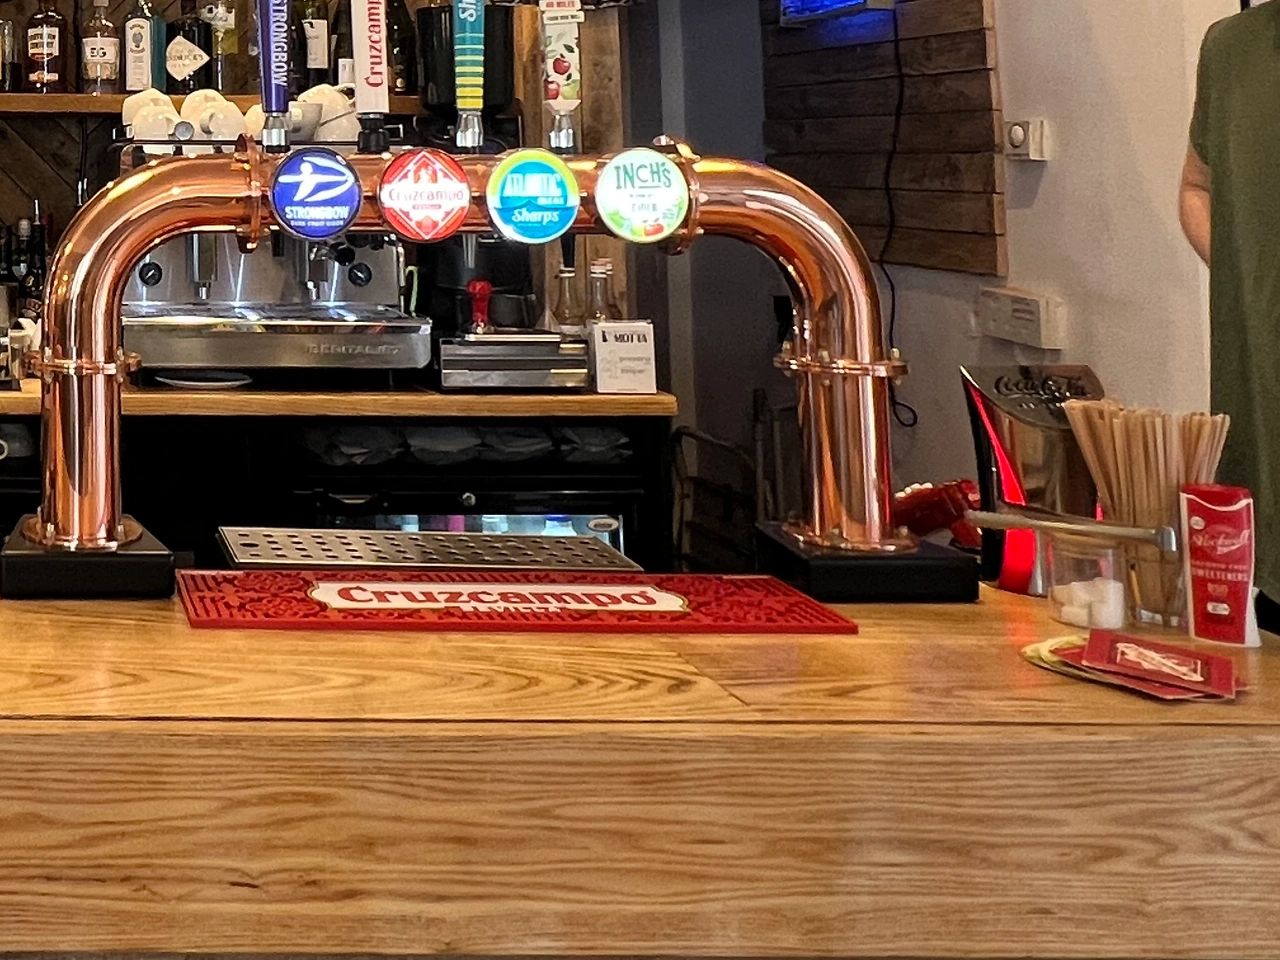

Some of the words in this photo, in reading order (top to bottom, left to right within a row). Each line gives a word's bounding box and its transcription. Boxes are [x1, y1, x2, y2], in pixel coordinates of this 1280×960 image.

[388, 188, 464, 202] Cruzcampo
[284, 206, 350, 220] STRONGBOW
[336, 585, 660, 608] Cruzcampo
